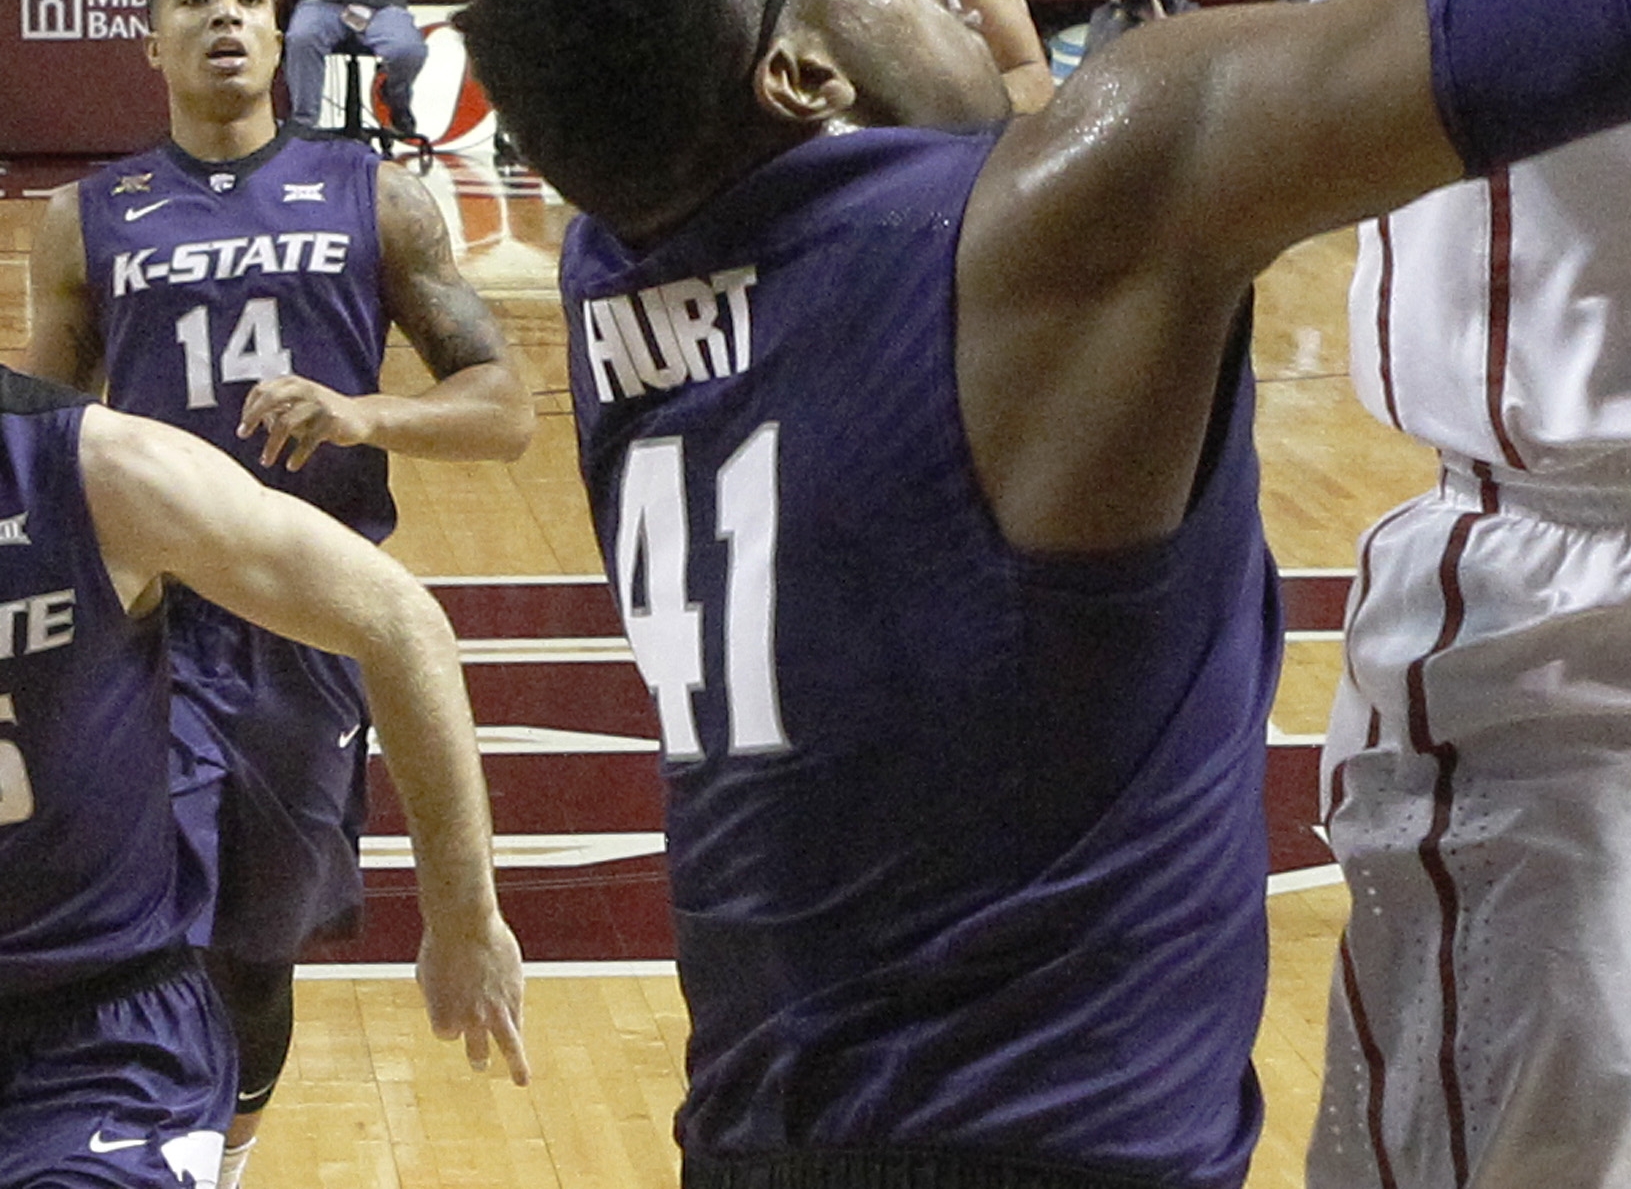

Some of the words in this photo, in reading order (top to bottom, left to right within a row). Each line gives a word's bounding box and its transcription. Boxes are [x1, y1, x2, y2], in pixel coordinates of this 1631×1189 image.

[113, 232, 350, 296] K-STATE
[175, 298, 292, 409] 14
[583, 265, 757, 403] HURT
[615, 420, 793, 762] 41
